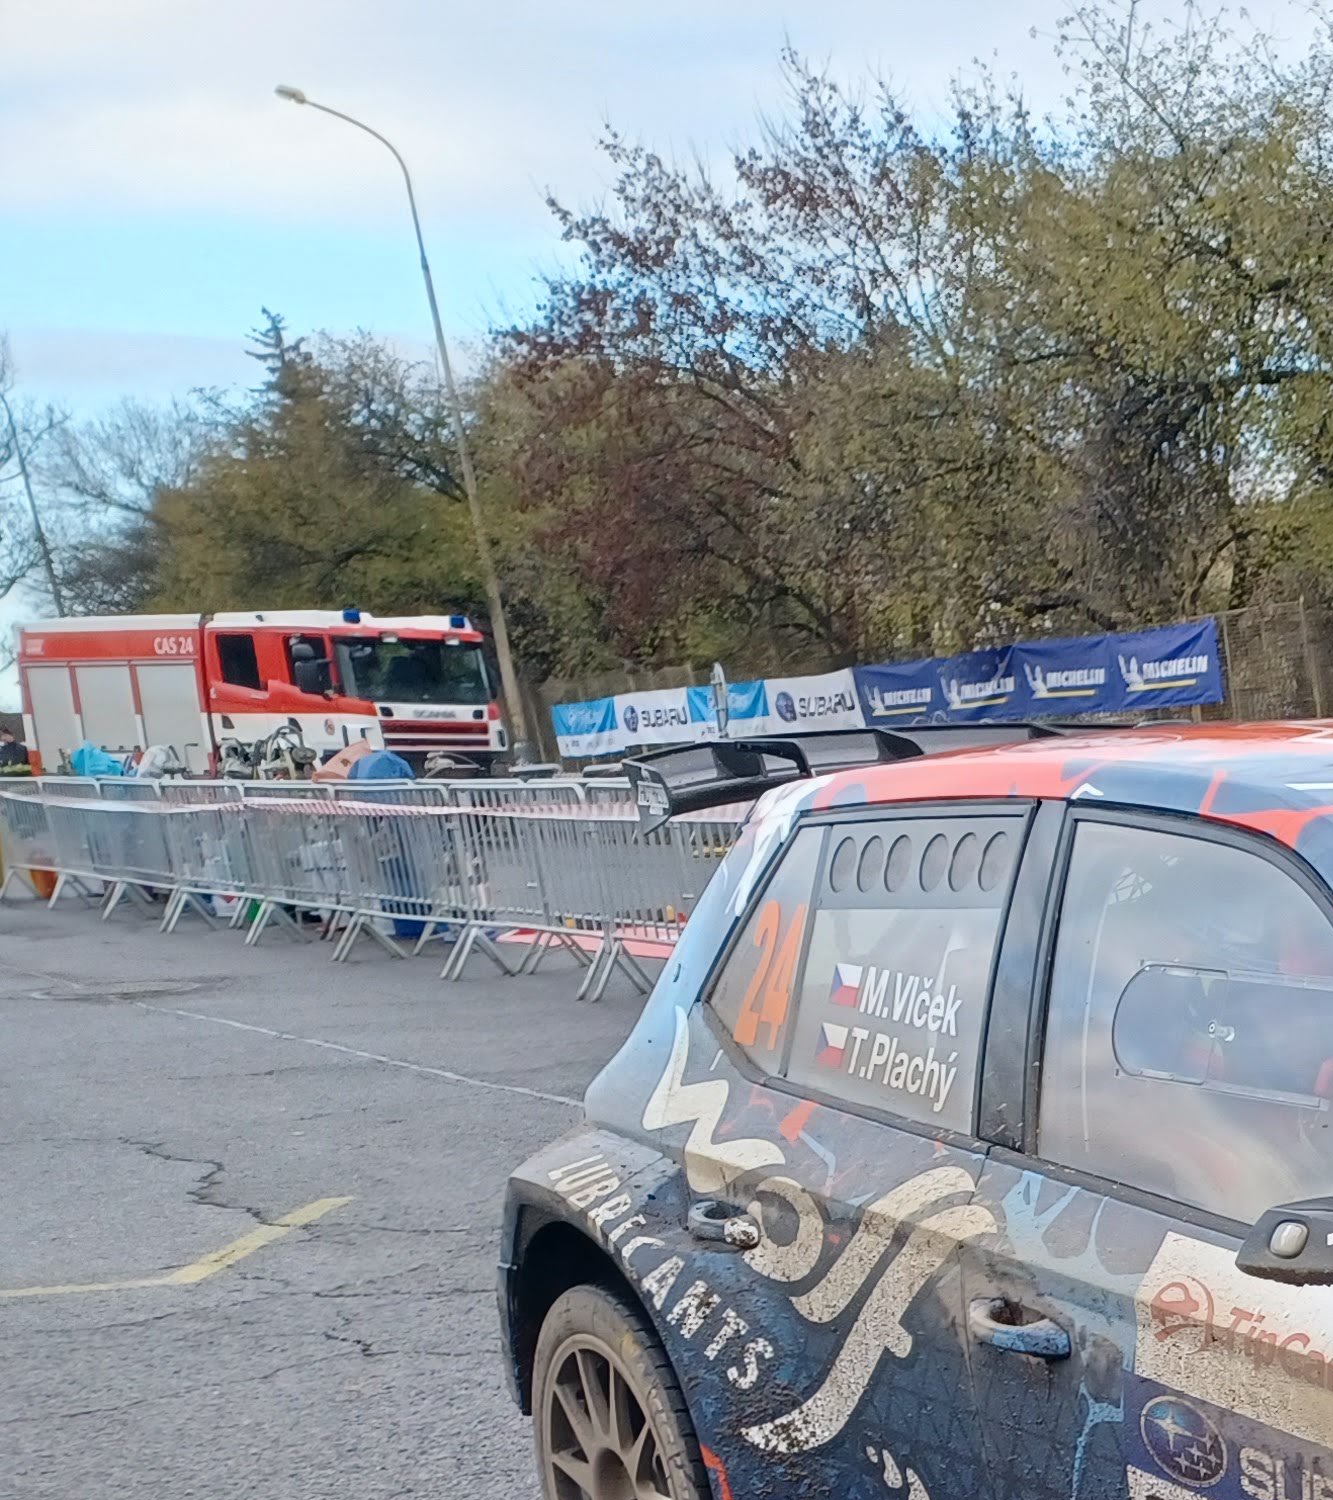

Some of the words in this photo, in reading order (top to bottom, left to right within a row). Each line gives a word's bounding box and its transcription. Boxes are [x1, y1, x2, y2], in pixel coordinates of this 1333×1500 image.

[154, 637, 177, 655] CAS
[178, 636, 194, 654] 24
[1046, 668, 1105, 687] MICHELIN
[1142, 655, 1208, 679] MICHELIN
[799, 690, 856, 718] SUBARU
[733, 899, 806, 1051] 24
[858, 966, 963, 1037] M.Vlček
[845, 1027, 959, 1112] T.Plachý
